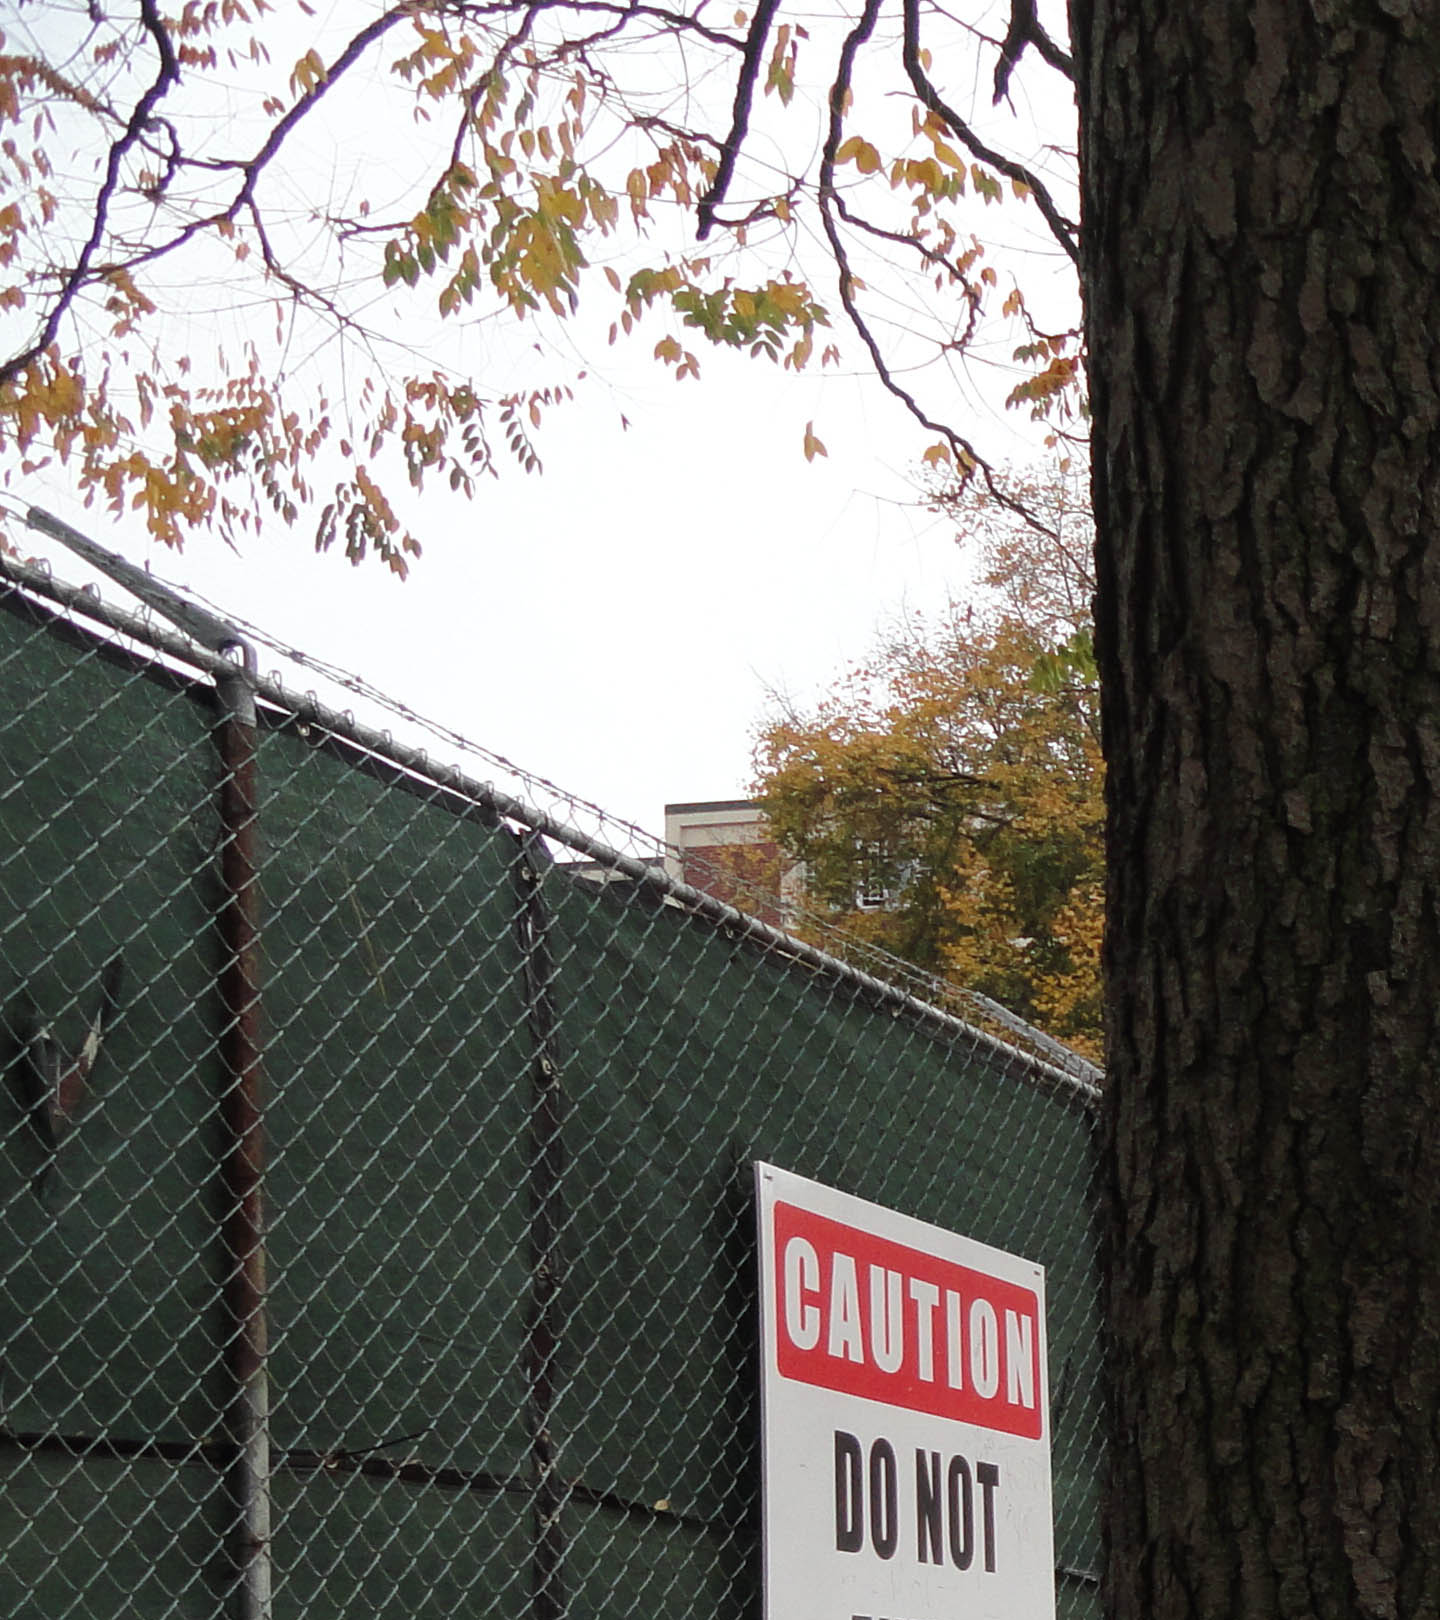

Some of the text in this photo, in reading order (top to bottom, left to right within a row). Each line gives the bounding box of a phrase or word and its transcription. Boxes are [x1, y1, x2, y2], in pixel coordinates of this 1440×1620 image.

[783, 1236, 1035, 1410] CAUTION
[834, 1430, 999, 1573] DO NOT
